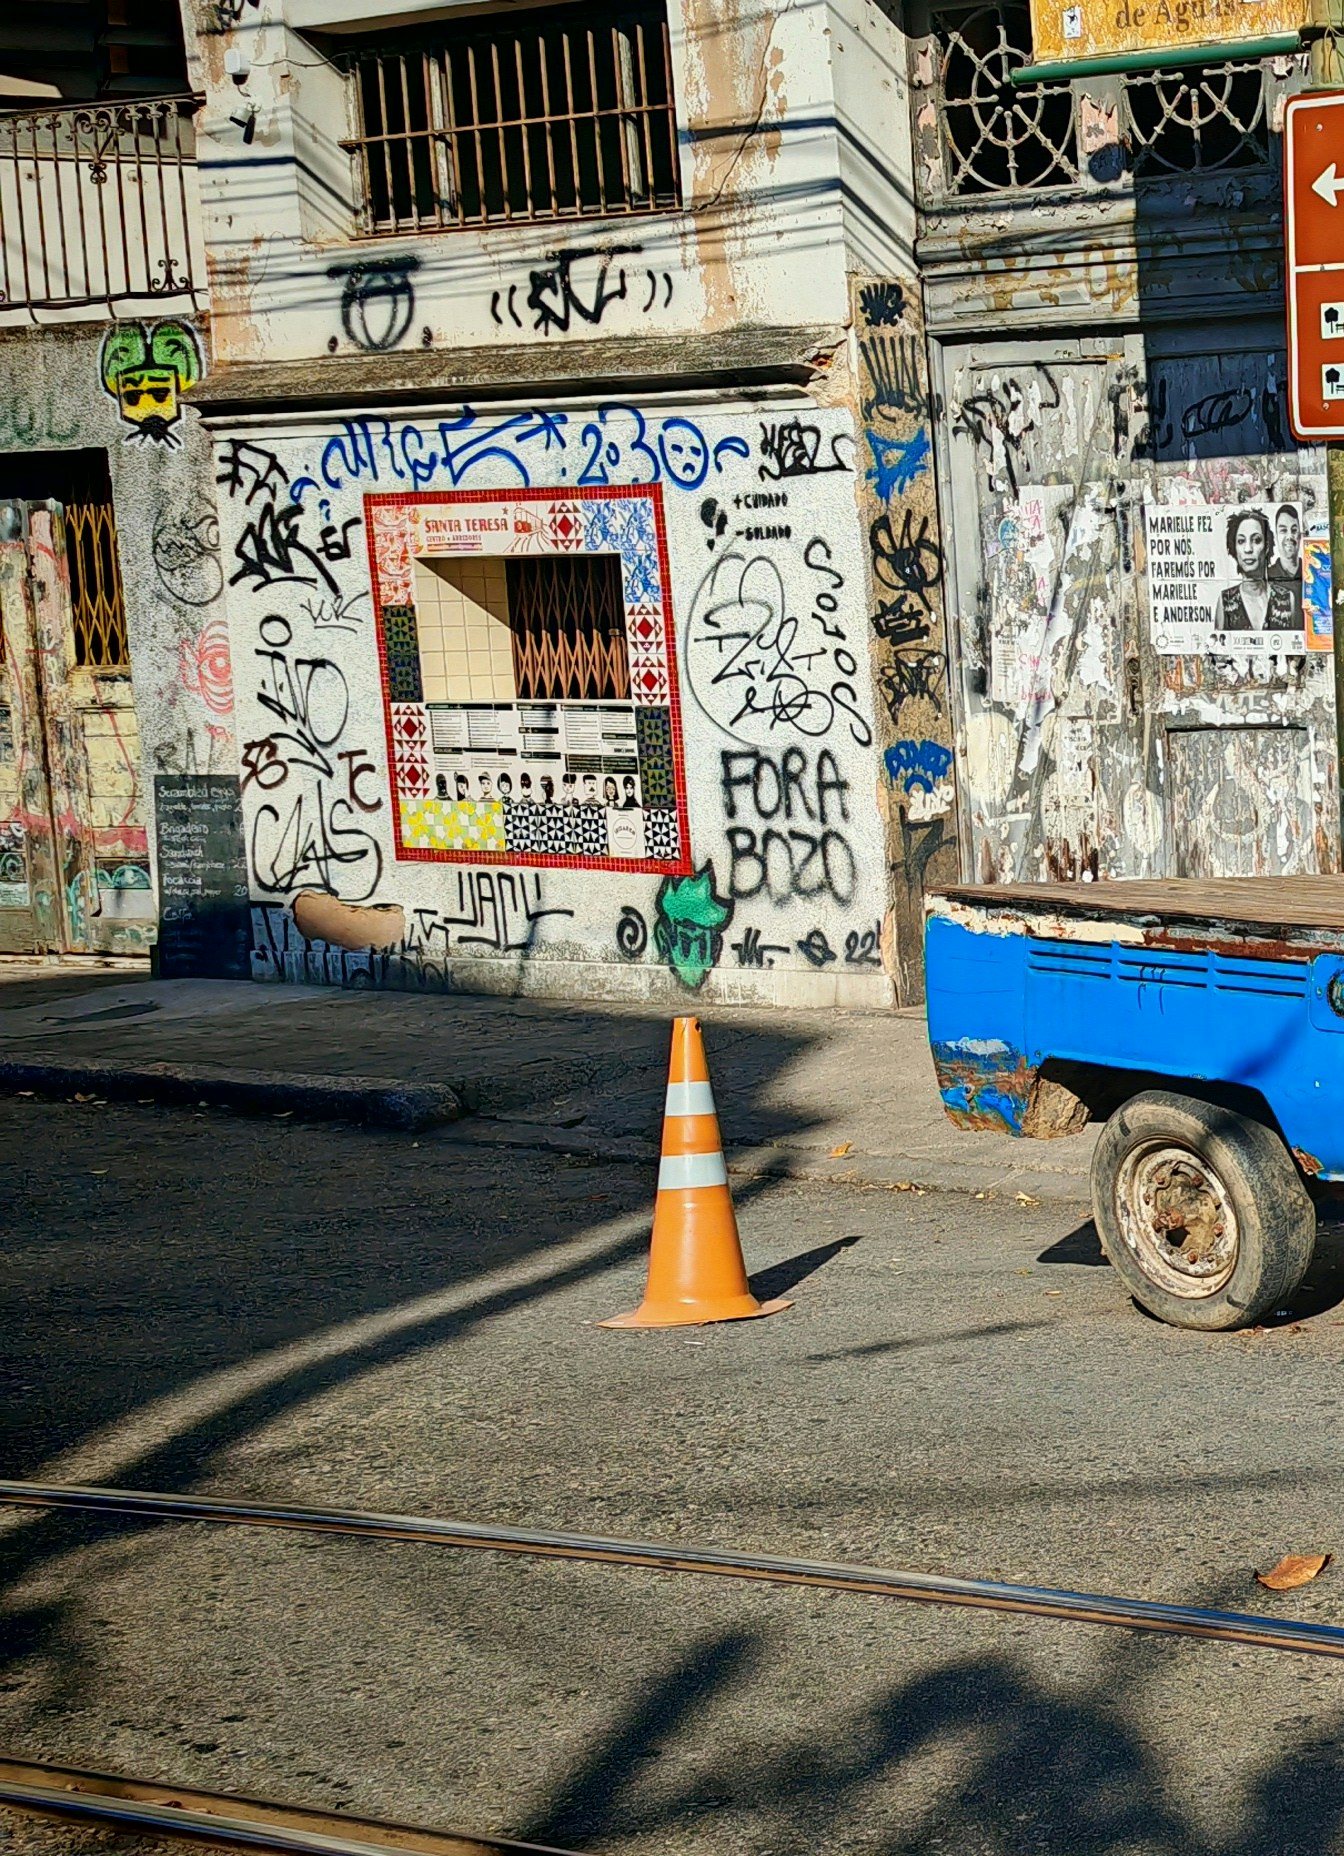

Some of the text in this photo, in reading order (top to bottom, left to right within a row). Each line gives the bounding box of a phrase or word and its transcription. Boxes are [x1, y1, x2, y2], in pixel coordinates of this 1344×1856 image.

[425, 518, 509, 533] SANTA TERESA
[1149, 515, 1213, 533] MARIELLE FEZ
[1150, 539, 1170, 555] POR
[1151, 561, 1216, 578] FAREMOS POR
[1152, 583, 1197, 600] MARIELLE
[1153, 606, 1159, 623] E
[158, 783, 208, 798] Scrambled
[721, 746, 850, 825] FORA
[725, 826, 857, 907] BOZO
